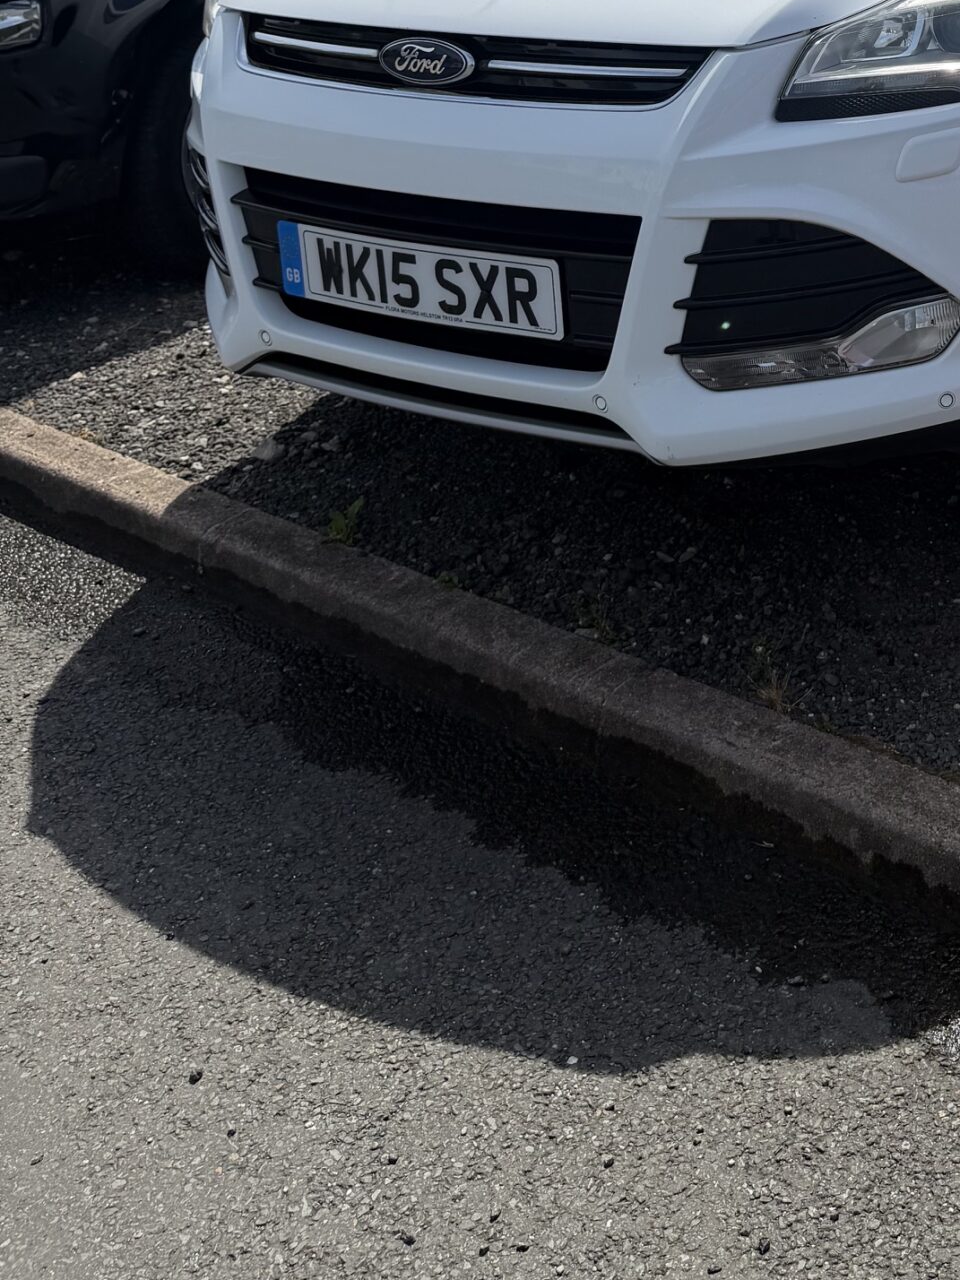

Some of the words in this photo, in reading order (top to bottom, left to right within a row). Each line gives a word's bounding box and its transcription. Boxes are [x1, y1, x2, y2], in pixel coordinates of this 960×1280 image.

[394, 44, 447, 74] Ford
[286, 268, 301, 283] GB
[316, 238, 420, 308] WK15
[434, 258, 540, 327] SXR
